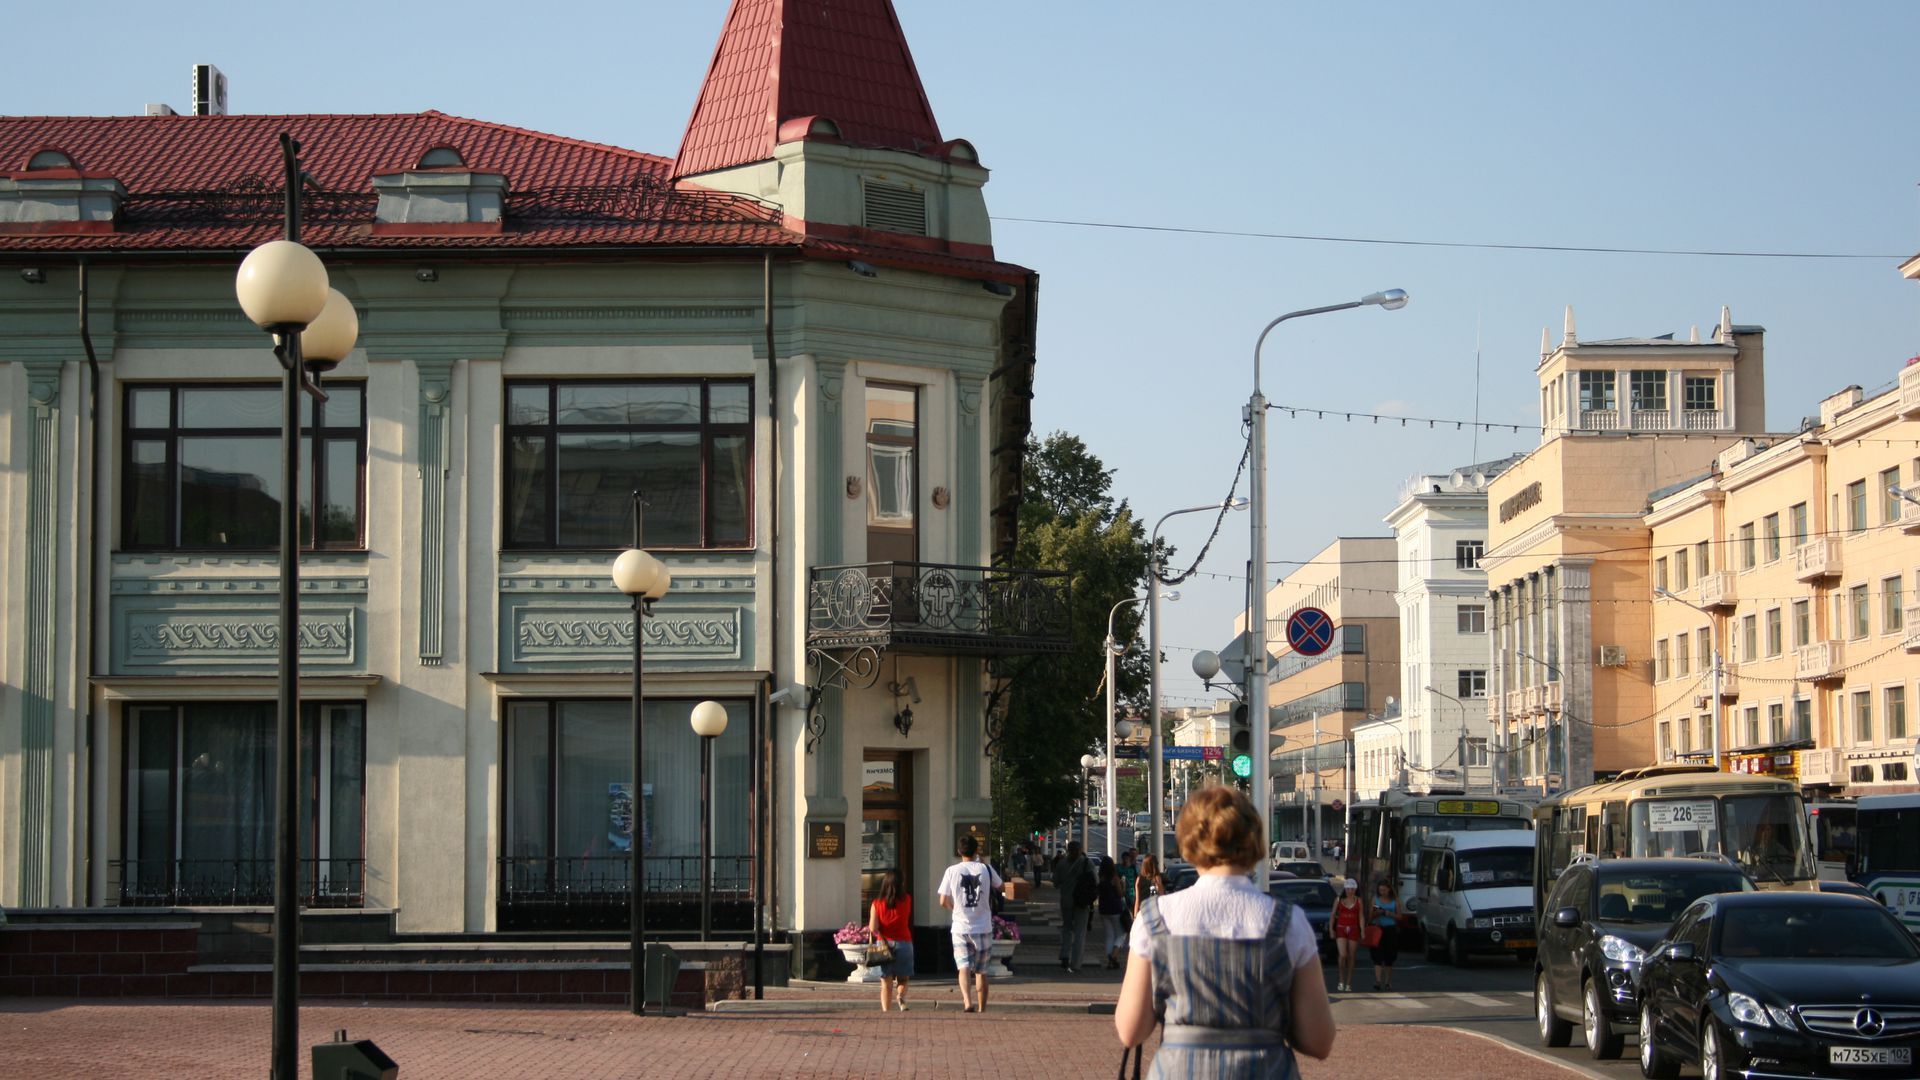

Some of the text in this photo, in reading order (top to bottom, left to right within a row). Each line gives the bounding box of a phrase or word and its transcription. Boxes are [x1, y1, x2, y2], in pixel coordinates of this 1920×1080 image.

[1204, 747, 1222, 755] 12%
[1673, 807, 1692, 822] 226
[1833, 1048, 1909, 1063] М735ХЕ 102
